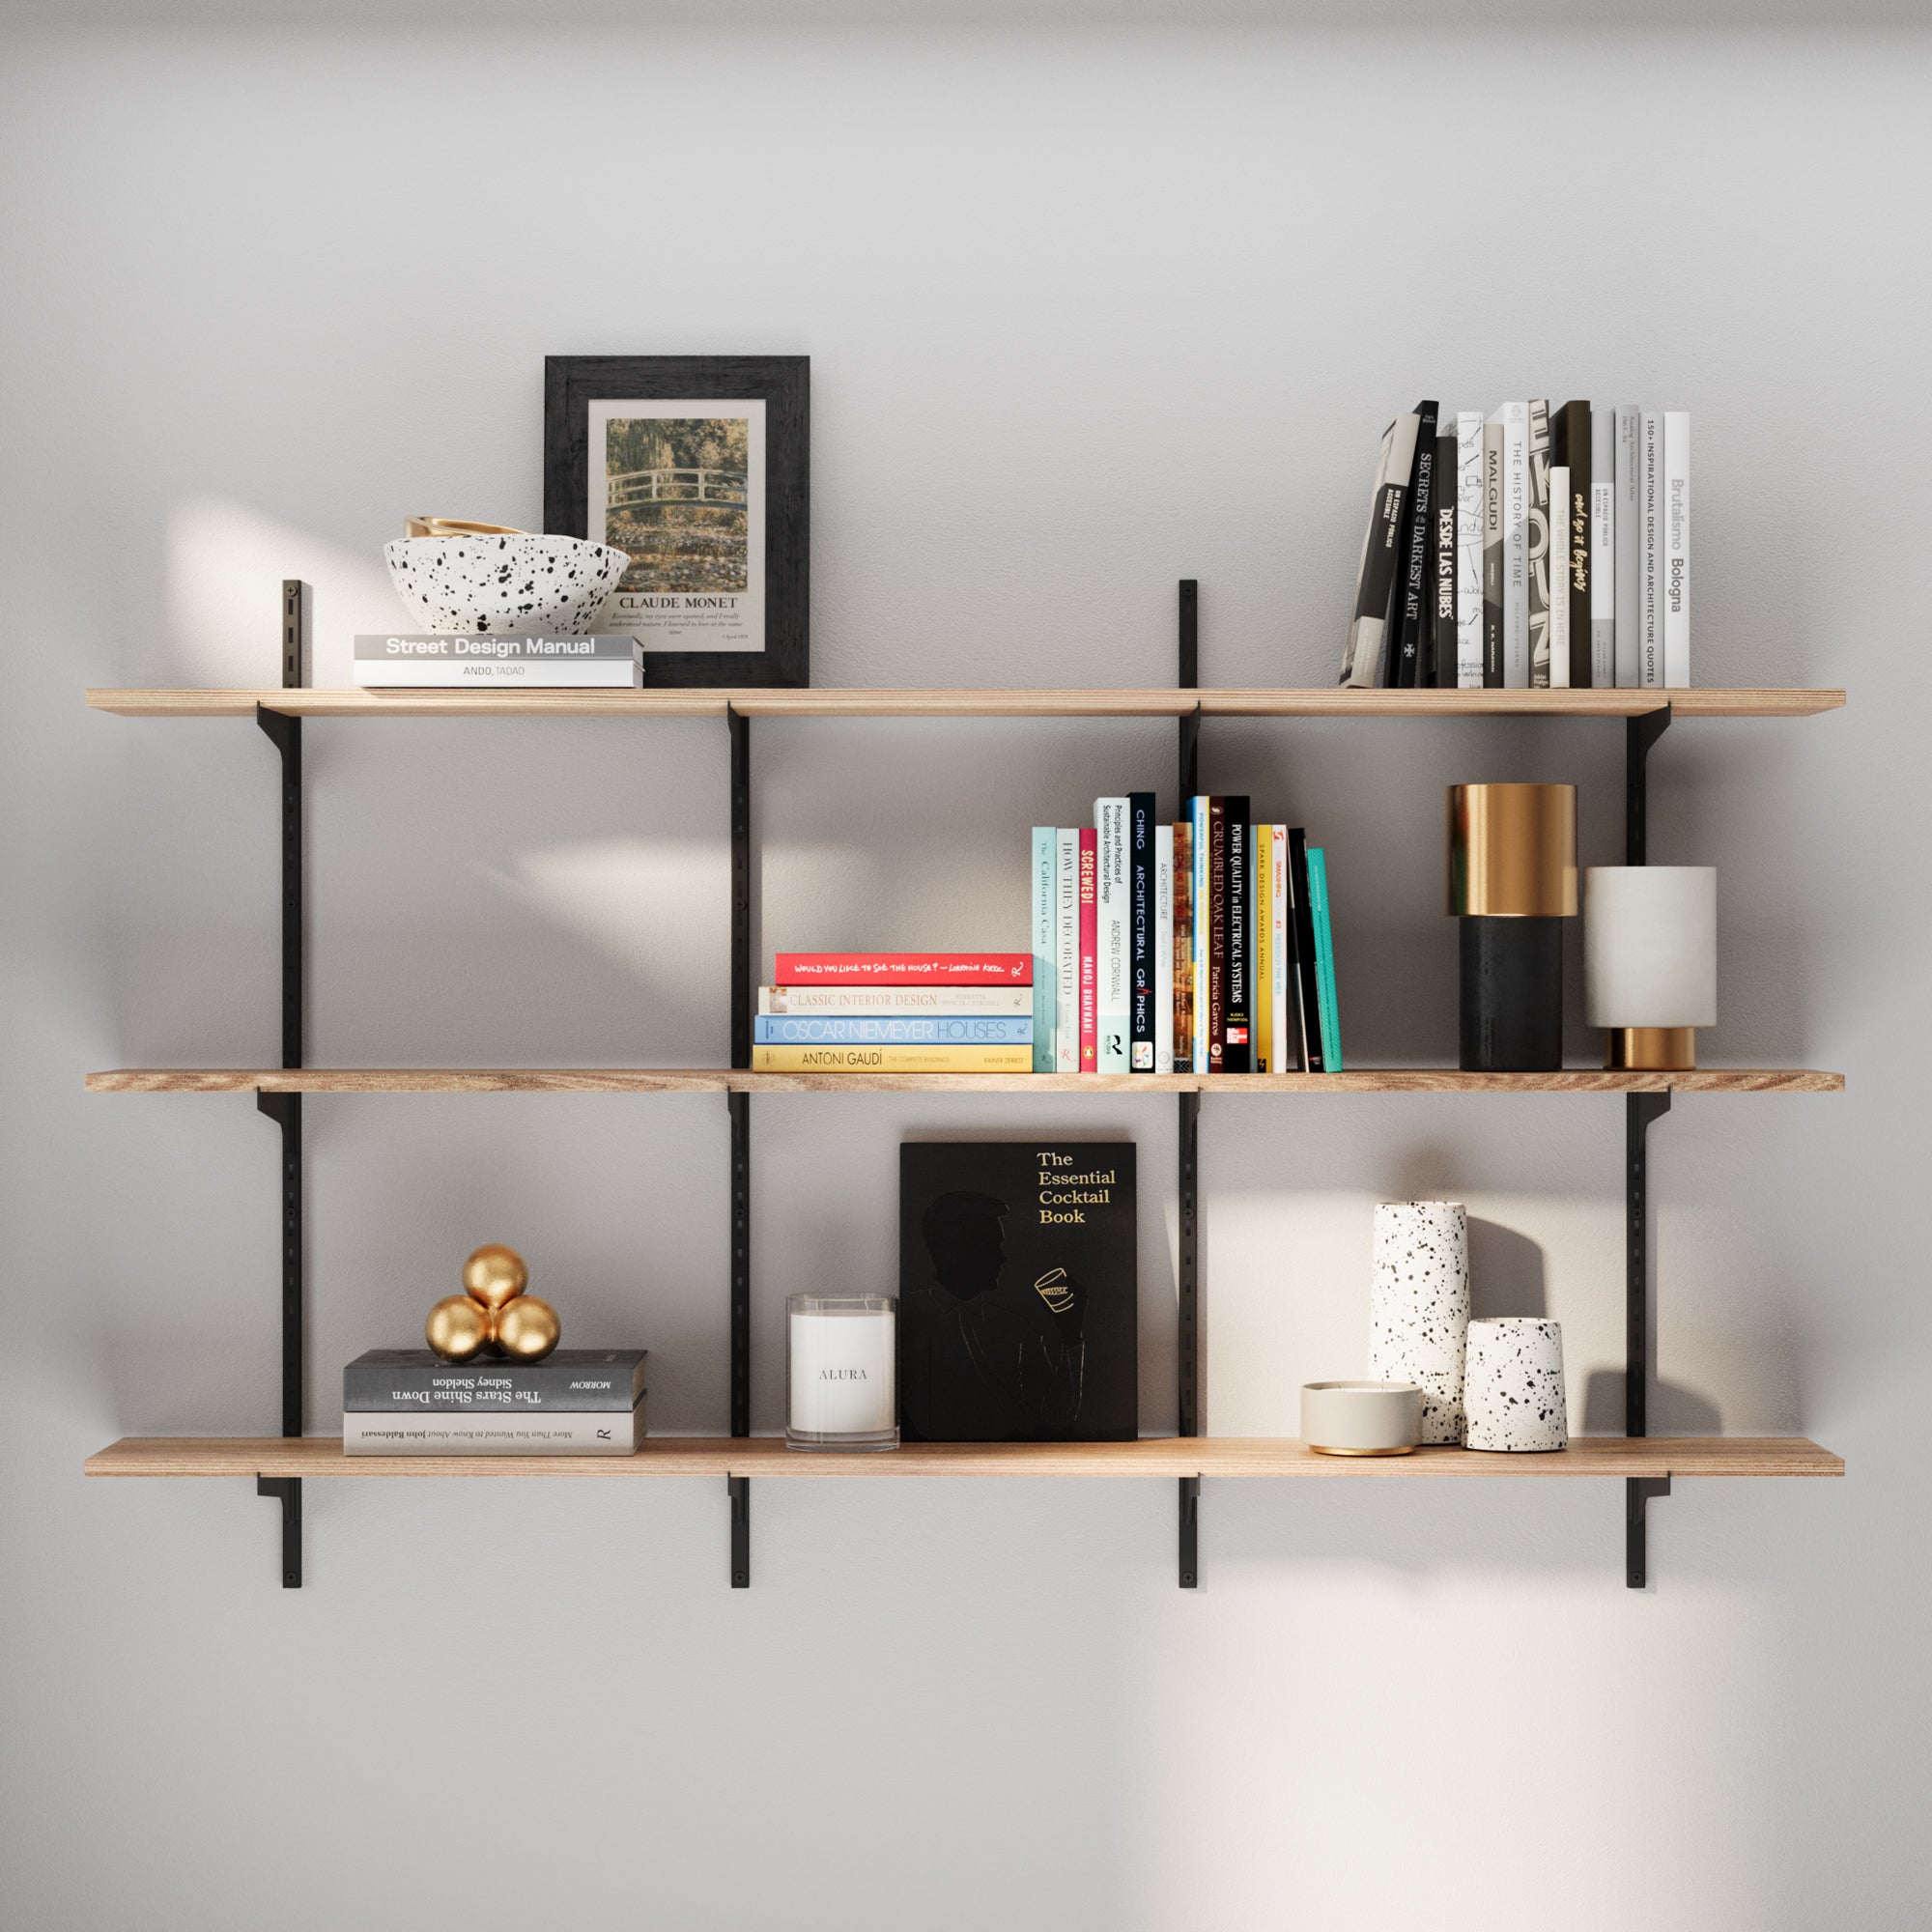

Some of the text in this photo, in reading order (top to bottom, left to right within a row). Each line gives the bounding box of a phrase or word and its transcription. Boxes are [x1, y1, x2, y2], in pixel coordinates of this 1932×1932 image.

[1416, 453, 1432, 513] SECRETS
[1489, 451, 1497, 530] MALGUDI
[1383, 489, 1393, 519] ACCESIBLE
[1391, 498, 1400, 522] ESPACIO
[1513, 441, 1521, 587] THE HISTORY OF TIME
[1575, 494, 1588, 518] and
[1574, 535, 1584, 546] it
[1669, 479, 1684, 612] Brutalismo Bologna
[1409, 526, 1425, 589] DARKEST
[1439, 553, 1452, 576] LAS
[1556, 510, 1564, 646] THE WHOLE STORY IS IN HERE
[619, 597, 739, 609] CLAUDE MONET
[1406, 592, 1418, 620] ART
[386, 638, 595, 657] Street Design Manual
[464, 667, 525, 676] ANDO, TADAO
[1113, 805, 1122, 833] Principles
[1232, 824, 1242, 854] POWER
[1063, 843, 1072, 870] HOW
[1041, 861, 1049, 915] California
[1213, 821, 1224, 958] CRUMBLED OAK LEAF
[1230, 856, 1242, 896] QUALITY
[1063, 875, 1072, 909] THEY
[1102, 882, 1111, 904] Design
[1041, 919, 1049, 944] Casa
[1136, 810, 1150, 1033] CHING ARCHITECTURAL GRAPHICS
[1232, 906, 1242, 960] ELECTRICAL
[795, 964, 822, 973] WOULD
[873, 963, 887, 972] SEE
[890, 963, 906, 972] THE
[908, 962, 938, 972] HOUSE?
[1063, 916, 1072, 995] DECORATED
[1111, 920, 1121, 1002] ANDREW CORNWALL
[1083, 956, 1093, 985] MANOJ
[1232, 962, 1242, 1003] SYSTEMS
[790, 994, 937, 1006] CLASSIC INTERIOR DESIGN
[1083, 989, 1093, 1033] BHAVNANI
[1212, 966, 1220, 1036] Patricia Gavros
[782, 1020, 846, 1039] OSCAR
[850, 1021, 934, 1039] NIEMEYER
[938, 1022, 1006, 1039] HOUSES
[802, 1052, 844, 1065] ANTONI
[847, 1048, 883, 1065] GAUDÍ
[1037, 1152, 1073, 1167] The
[1038, 1170, 1116, 1186] Essential
[1039, 1189, 1110, 1204] Cocktail
[1039, 1209, 1085, 1224] Book
[432, 1377, 512, 1388] Sidney Sheldon
[570, 1380, 611, 1389] MORROW
[819, 1369, 868, 1380] ALURA
[392, 1391, 542, 1403] The Stars Shine Down
